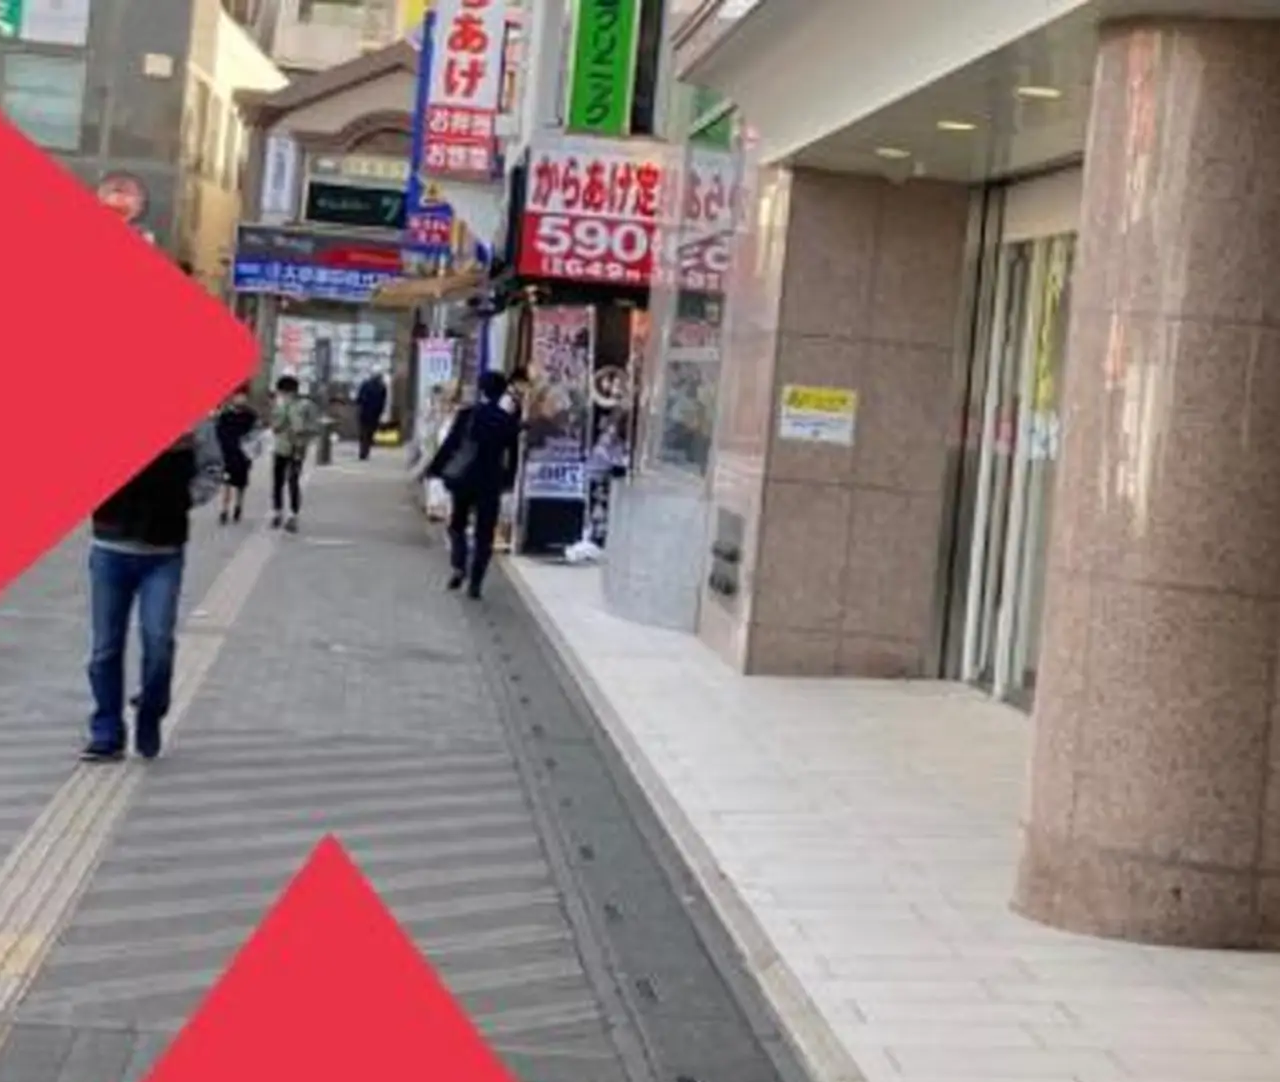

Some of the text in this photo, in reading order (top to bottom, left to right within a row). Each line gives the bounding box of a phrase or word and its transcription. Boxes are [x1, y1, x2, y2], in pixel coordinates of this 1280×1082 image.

[443, 0, 489, 98] あげ
[585, 0, 618, 125] クリニック
[534, 215, 649, 263] 590
